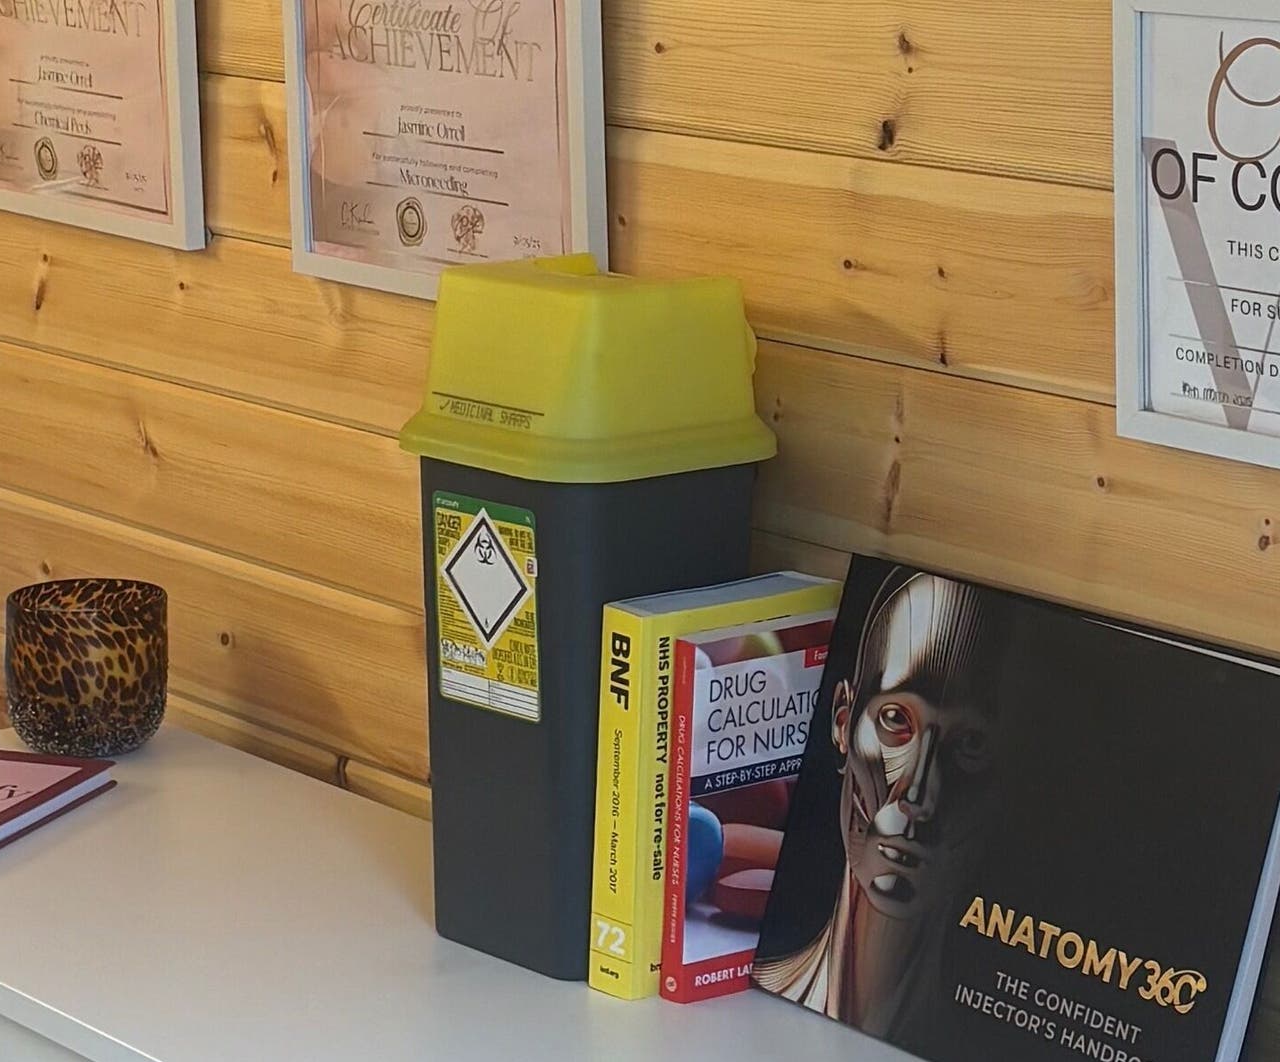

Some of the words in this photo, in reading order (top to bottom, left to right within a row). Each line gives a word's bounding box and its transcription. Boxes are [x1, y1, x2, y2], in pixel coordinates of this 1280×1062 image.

[348, 0, 462, 39] Certificate
[328, 24, 542, 82] ACHIEVEMENT
[1151, 148, 1216, 203] OF
[1227, 240, 1263, 260] THIS
[1231, 299, 1262, 319] FOR
[1175, 347, 1264, 377] COMPLETION
[609, 631, 632, 711] BNF
[658, 636, 670, 671] NHS
[709, 670, 766, 703] DRUG
[656, 675, 669, 764] PROPERTY
[677, 714, 686, 744] DRUG
[612, 727, 623, 788] September
[707, 735, 745, 764] FOR
[753, 721, 808, 754] NURS
[654, 773, 665, 798] not
[674, 747, 685, 822] CALCULATIONS
[704, 778, 713, 790] A
[715, 764, 777, 788] STEP-BY-STEP
[611, 789, 621, 819] 2016
[654, 801, 665, 824] for
[609, 830, 620, 865] March
[673, 824, 681, 843] FOR
[652, 827, 664, 881] re-sale
[671, 847, 680, 885] NURSES
[608, 867, 618, 894] 2017
[596, 920, 626, 956] 72
[695, 967, 735, 987] ROBERT
[954, 983, 1056, 1041] INJECTOR'S
[995, 971, 1029, 999] THE
[1034, 987, 1142, 1045] CONFIDENT
